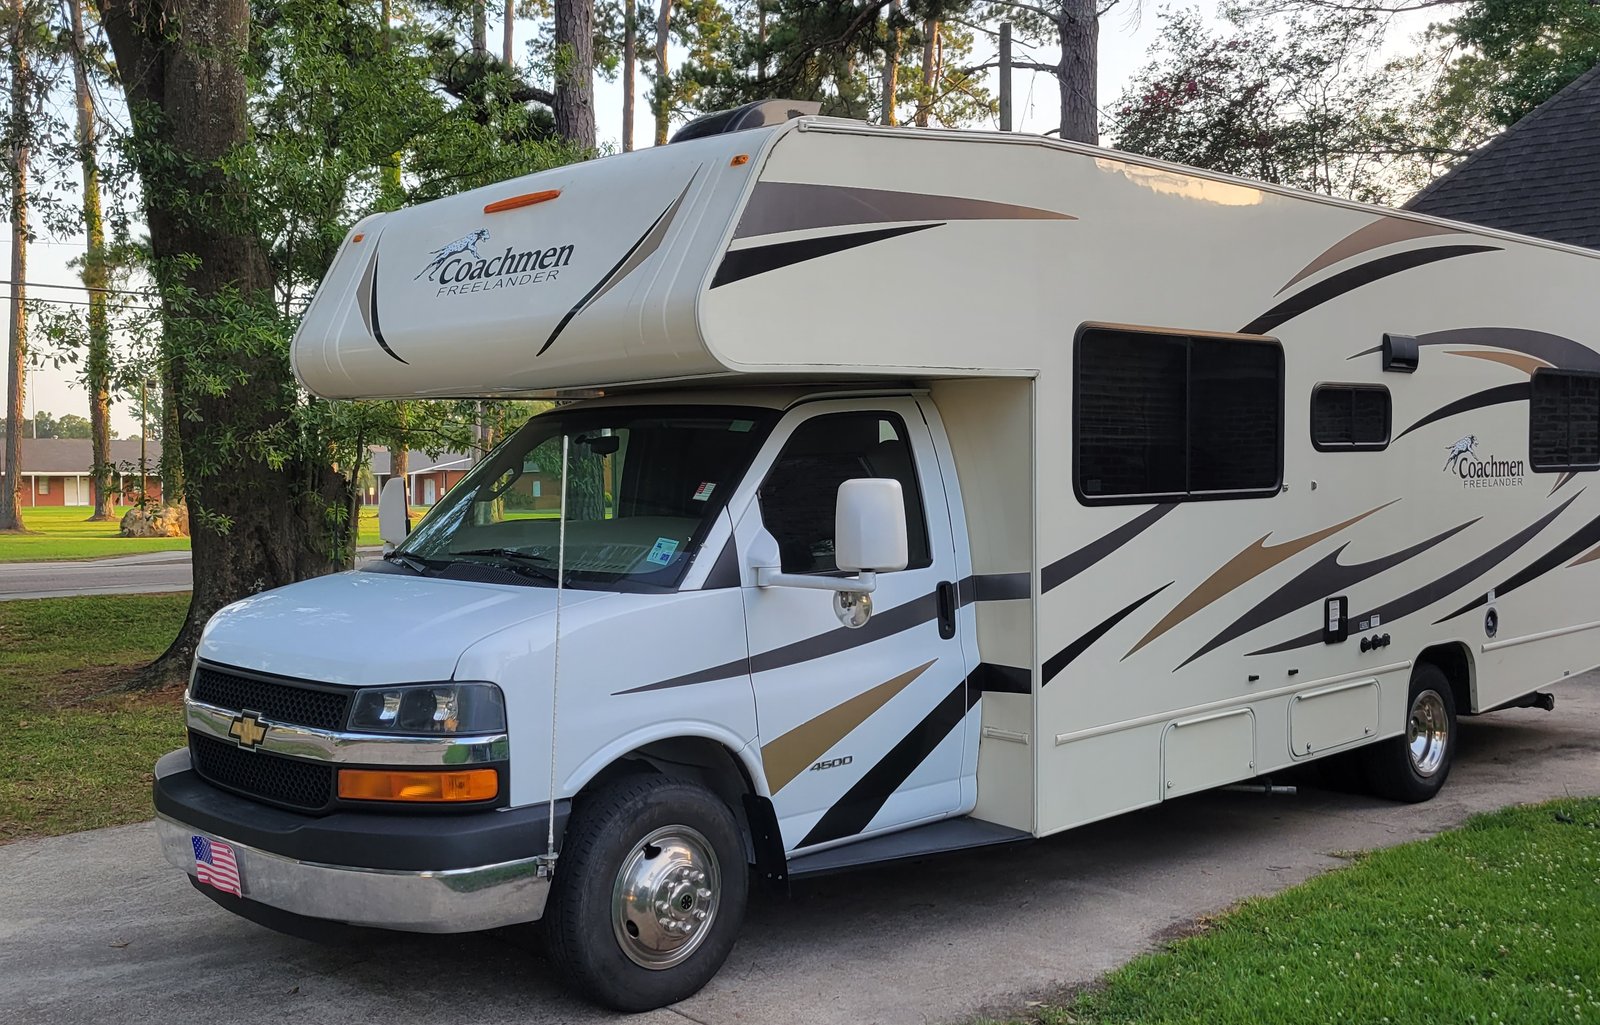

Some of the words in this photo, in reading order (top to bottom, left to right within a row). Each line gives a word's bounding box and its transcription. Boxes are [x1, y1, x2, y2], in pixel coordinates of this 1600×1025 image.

[439, 244, 575, 285] Coachmen
[436, 269, 560, 298] FREELANDER
[1459, 454, 1524, 479] Coachmen
[1463, 477, 1523, 488] FREELANDER
[810, 755, 853, 771] 4500
